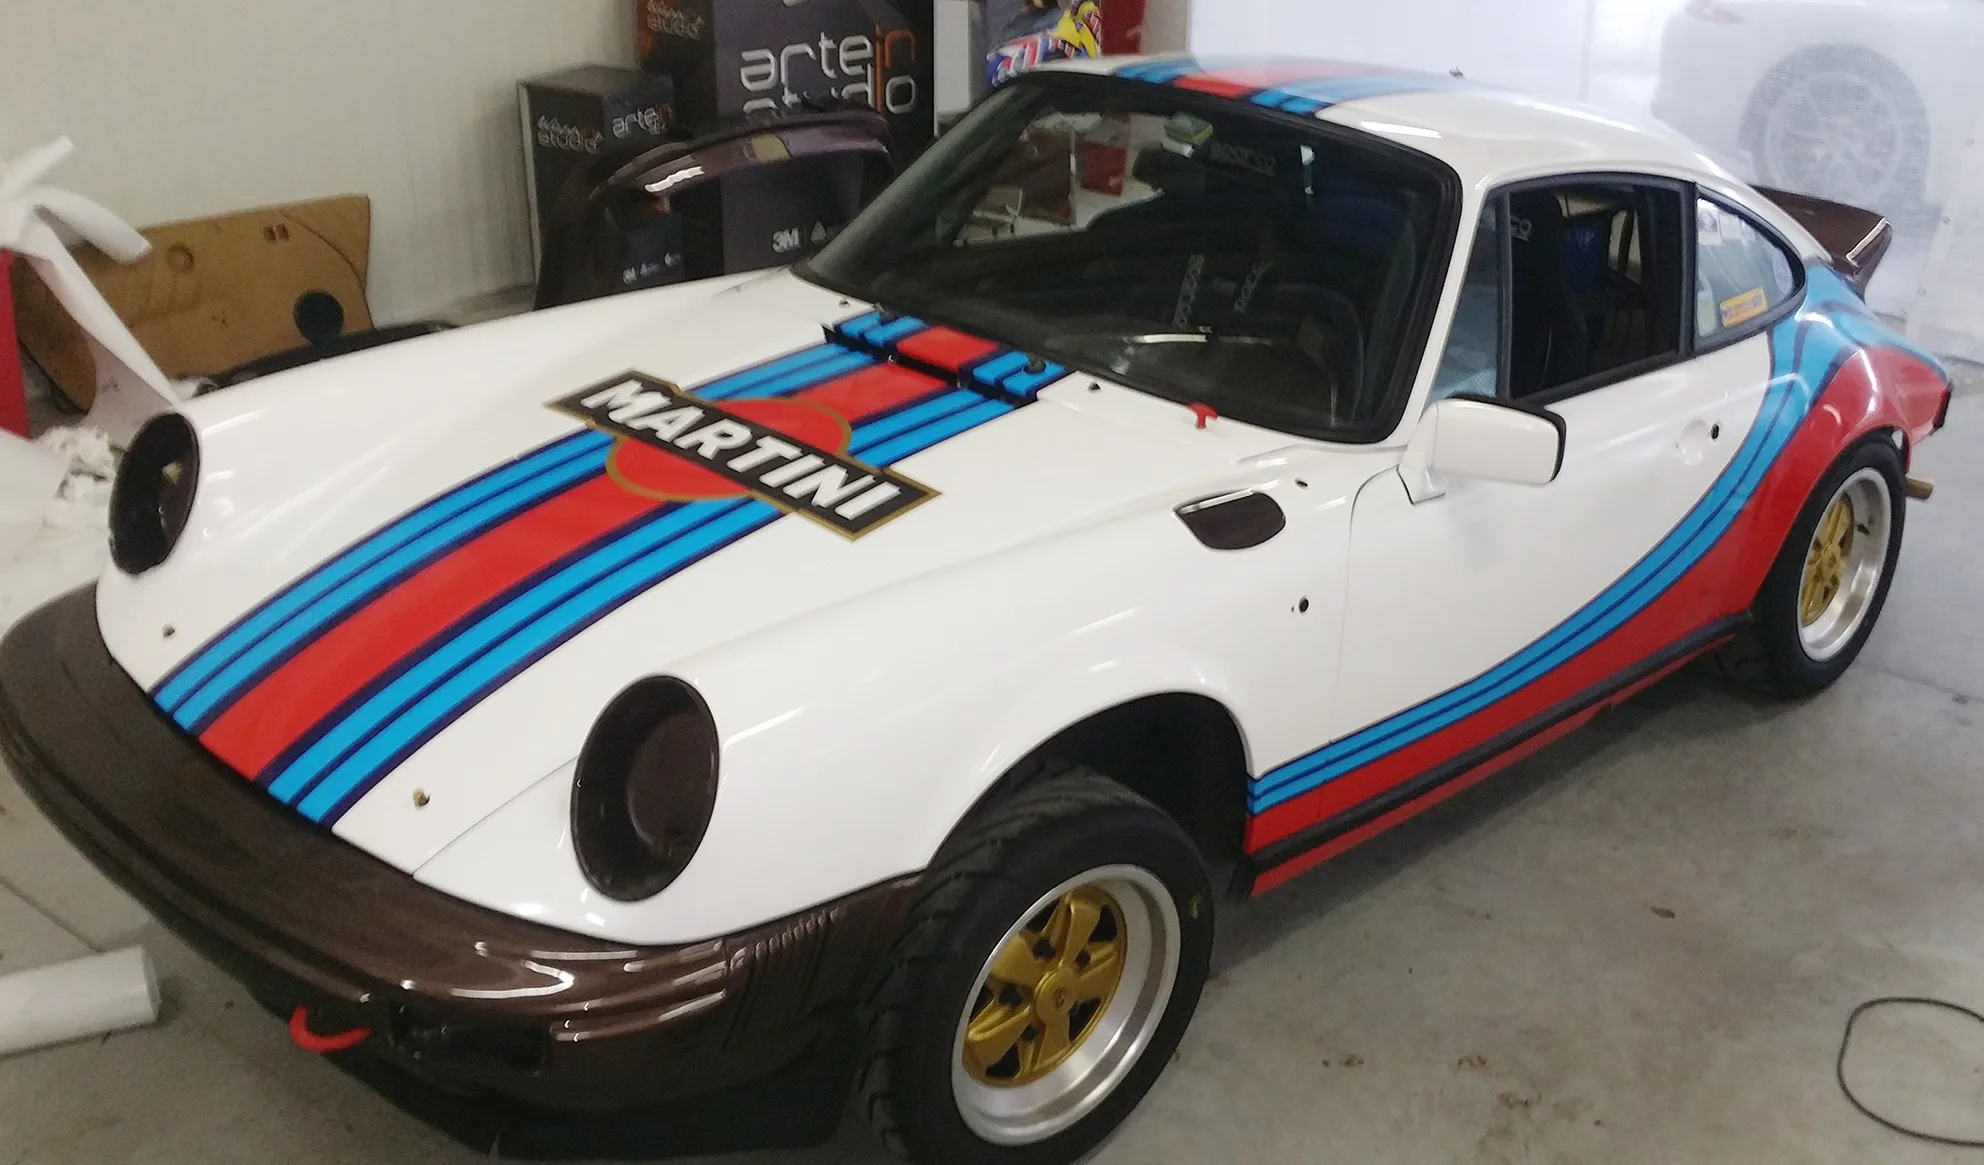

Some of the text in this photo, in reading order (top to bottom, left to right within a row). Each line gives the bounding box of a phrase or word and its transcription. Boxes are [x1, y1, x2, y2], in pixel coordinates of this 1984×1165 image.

[740, 24, 917, 92] artein
[772, 228, 800, 253] 3M
[581, 378, 902, 520] MARTINI
